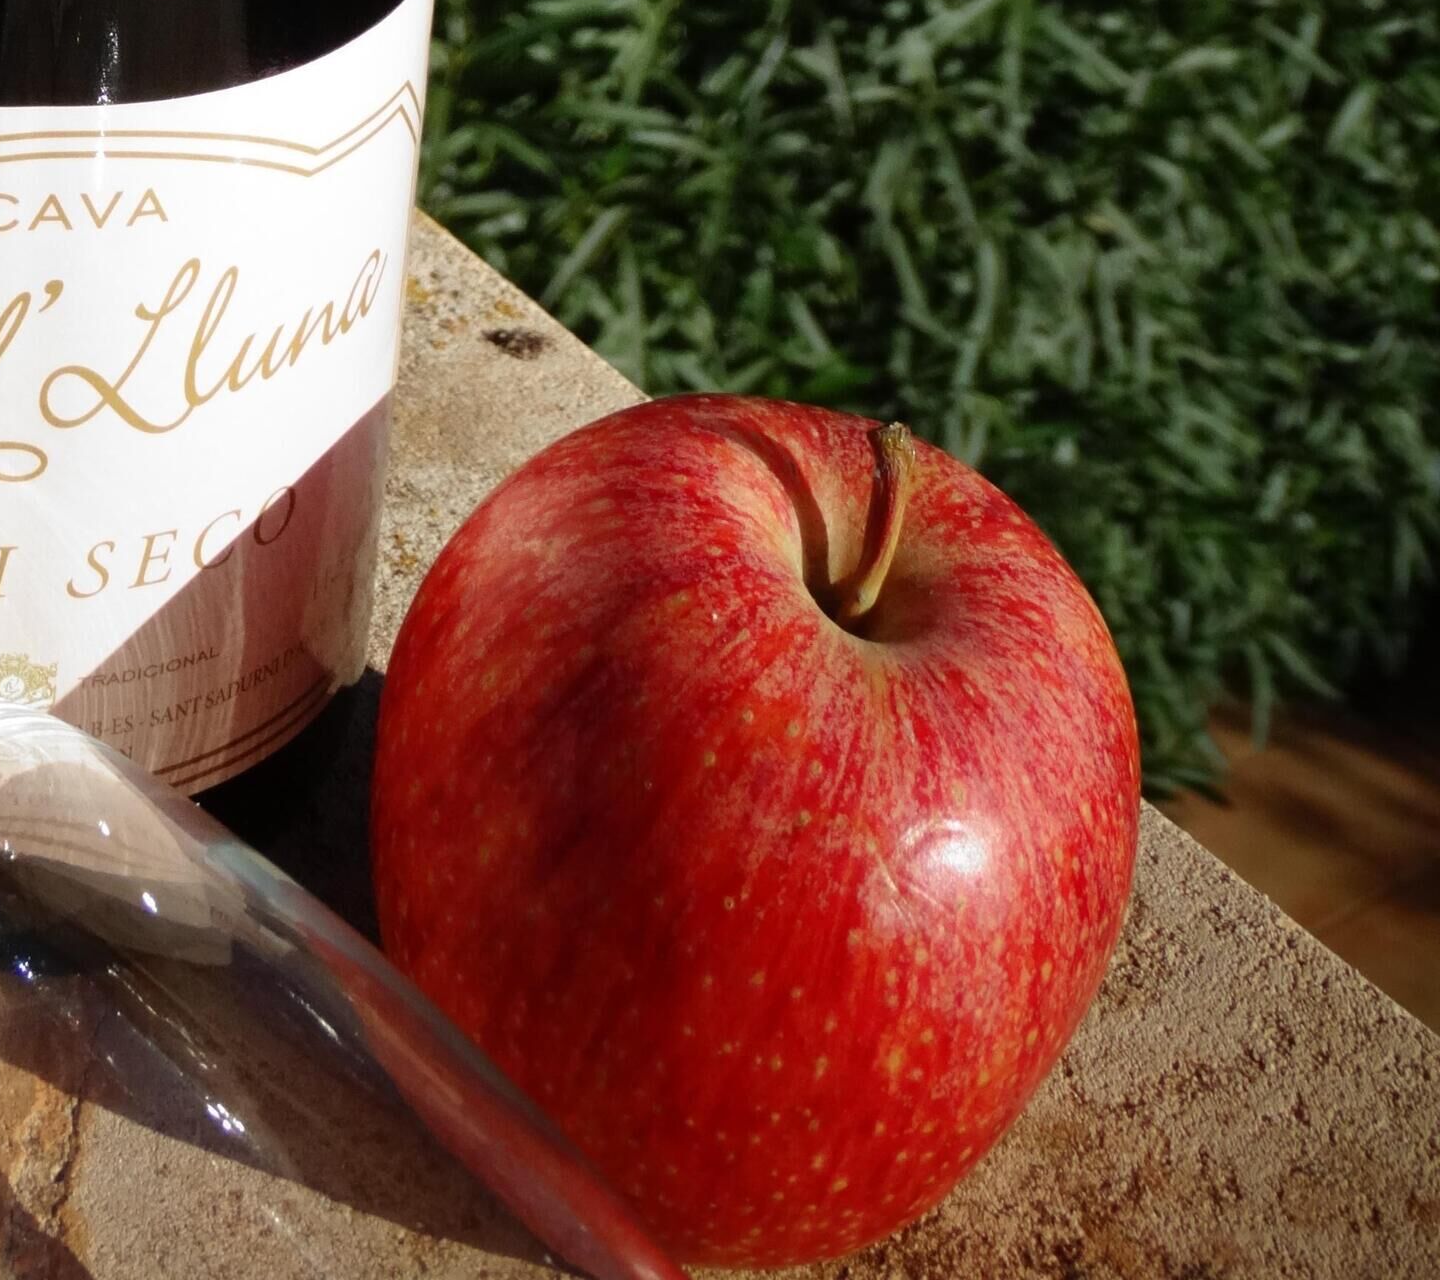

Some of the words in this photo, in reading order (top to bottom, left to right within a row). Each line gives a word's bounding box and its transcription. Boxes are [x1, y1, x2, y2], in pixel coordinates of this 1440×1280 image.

[38, 248, 388, 435] Lluna
[66, 485, 297, 600] SECO
[77, 646, 221, 690] TRADICIONAL
[148, 694, 202, 731] SANT
